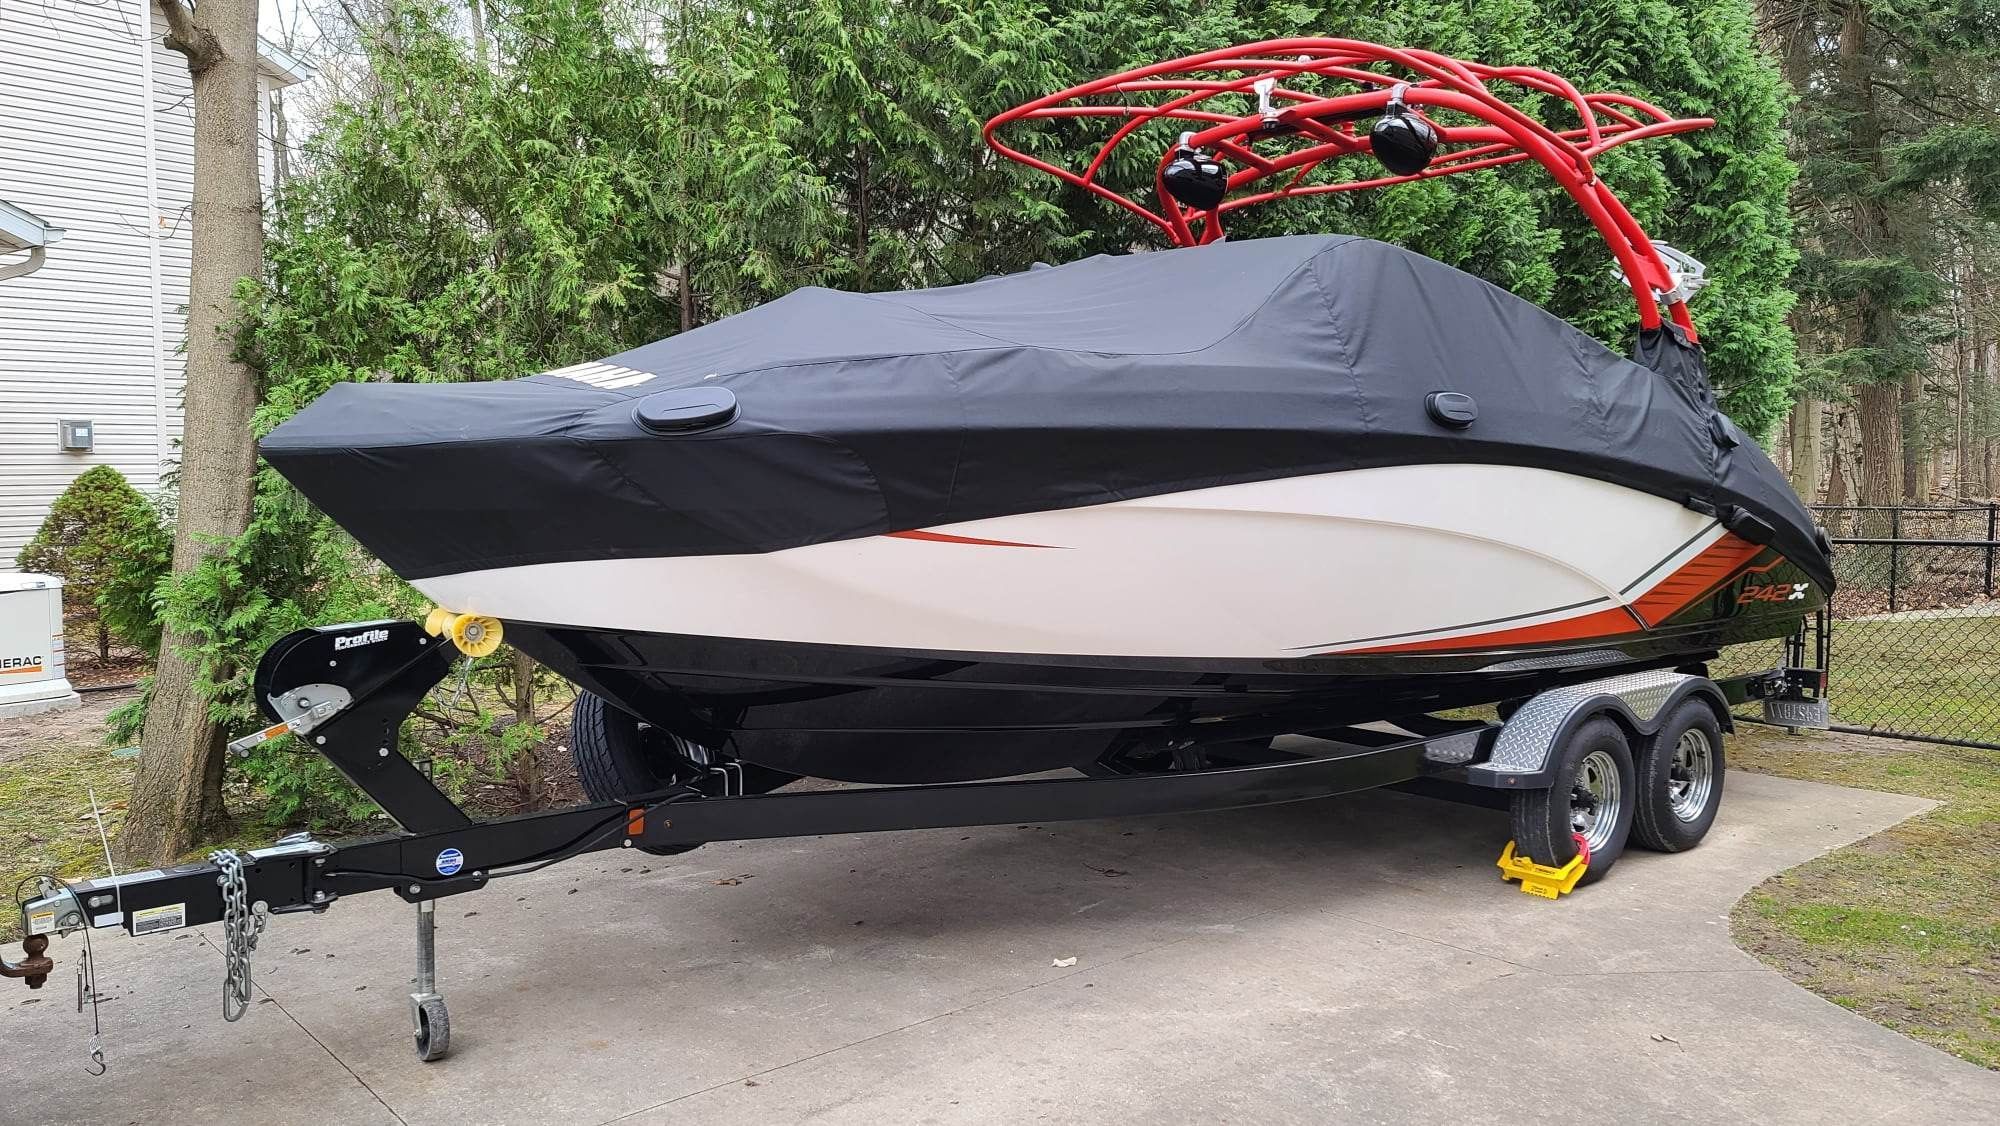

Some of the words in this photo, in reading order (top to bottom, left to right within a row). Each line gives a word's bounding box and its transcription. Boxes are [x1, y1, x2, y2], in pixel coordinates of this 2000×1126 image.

[1736, 583, 1809, 604] 242X
[335, 629, 389, 649] Profile
[0, 656, 42, 669] ERAC
